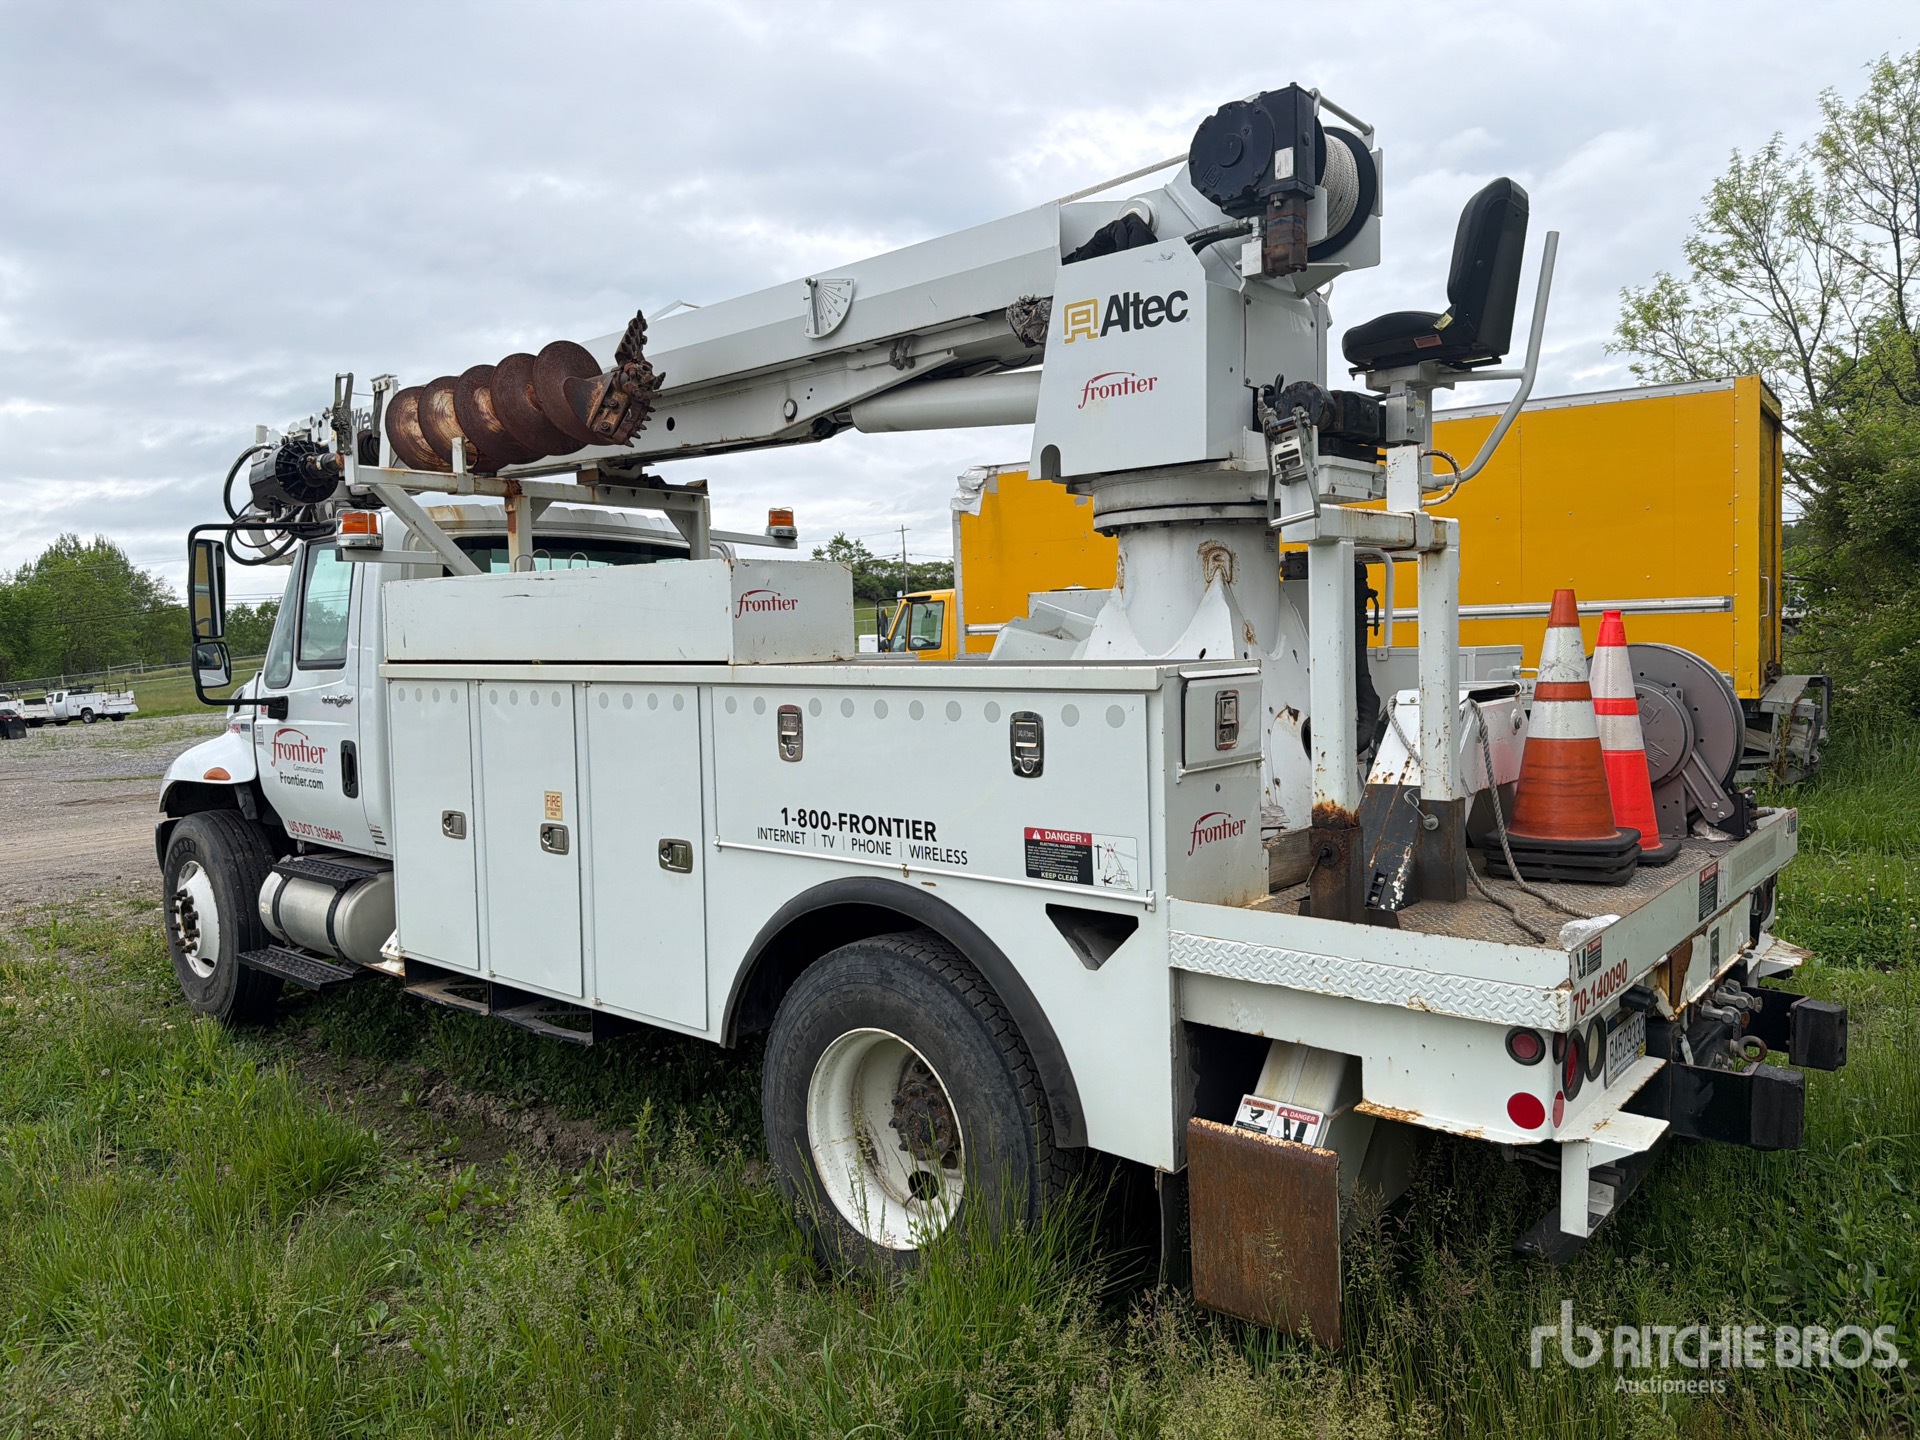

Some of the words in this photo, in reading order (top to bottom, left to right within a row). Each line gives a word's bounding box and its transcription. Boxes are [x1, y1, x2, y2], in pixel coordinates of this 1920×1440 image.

[1100, 290, 1189, 337] Altec
[1078, 372, 1158, 409] frontier
[735, 590, 799, 619] frontier
[271, 728, 327, 766] frontier
[280, 772, 324, 790] Frontier.com
[288, 820, 299, 832] US
[299, 822, 314, 836] DOT
[780, 807, 937, 842] 1-800-FRONTIER
[1045, 831, 1082, 843] DANGER
[1188, 811, 1246, 856] frontier
[757, 827, 806, 845] INTERNET
[821, 835, 835, 848] TV
[851, 838, 892, 856] PHONE
[909, 845, 968, 866] WIRELESS
[1058, 874, 1078, 883] CLEAR
[1573, 958, 1627, 1021] 70-140090
[1290, 1111, 1315, 1122] DANGER
